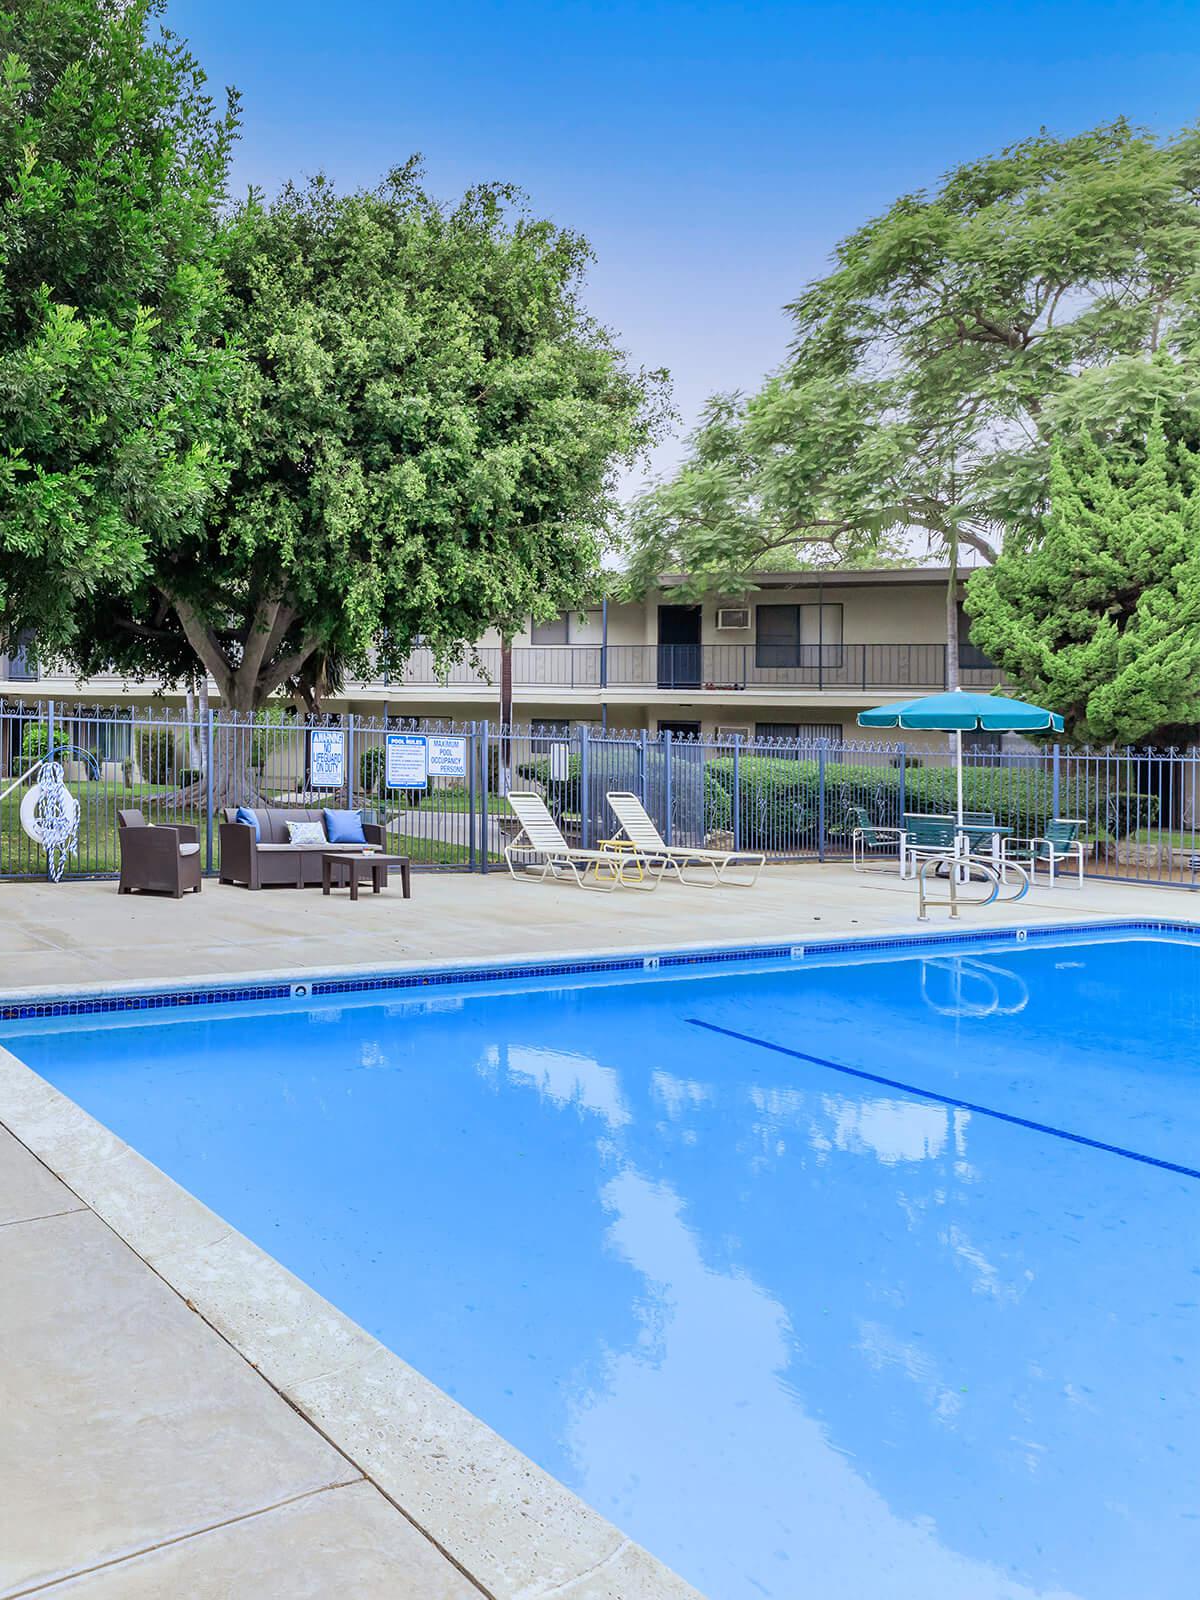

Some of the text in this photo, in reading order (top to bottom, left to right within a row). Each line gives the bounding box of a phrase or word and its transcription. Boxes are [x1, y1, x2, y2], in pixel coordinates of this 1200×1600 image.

[433, 739, 459, 747] MAXIMUM
[323, 743, 331, 753] NO
[439, 748, 452, 756] POOL
[313, 752, 342, 763] LIFEGUARD
[431, 756, 461, 765] OCCUPANCY
[316, 762, 338, 772] ON DUTY
[440, 764, 464, 772] PERSONS
